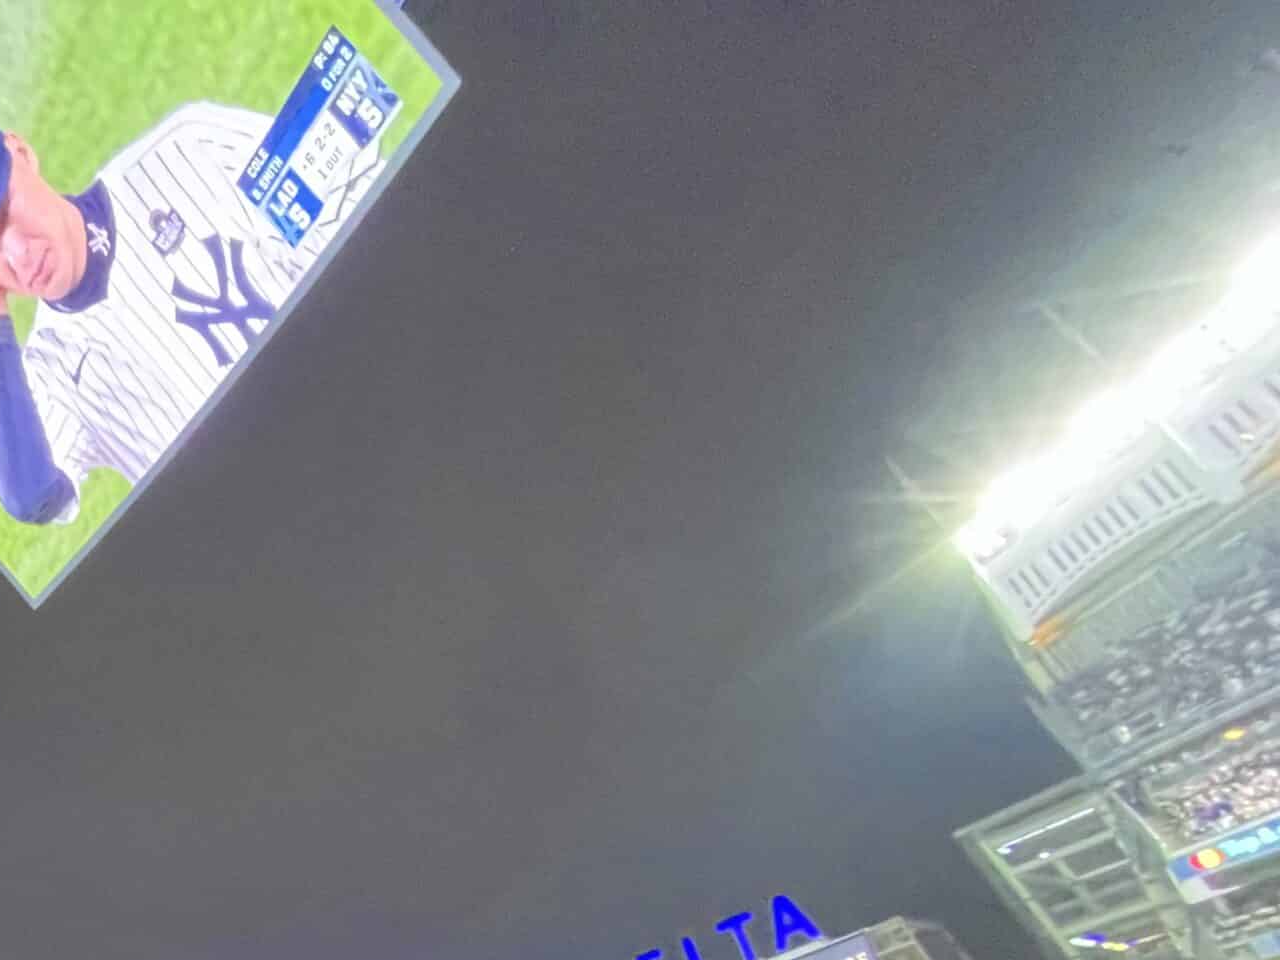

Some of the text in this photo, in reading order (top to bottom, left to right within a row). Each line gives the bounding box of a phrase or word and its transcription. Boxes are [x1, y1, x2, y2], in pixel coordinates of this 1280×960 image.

[340, 45, 354, 62] 2
[335, 67, 368, 116] NYY
[356, 96, 383, 129] 5
[314, 122, 337, 152] 2-2
[247, 146, 270, 179] COLE
[258, 155, 285, 191] SMITH
[327, 145, 345, 170] OUT
[269, 178, 300, 217] LAD
[287, 203, 312, 231] 5
